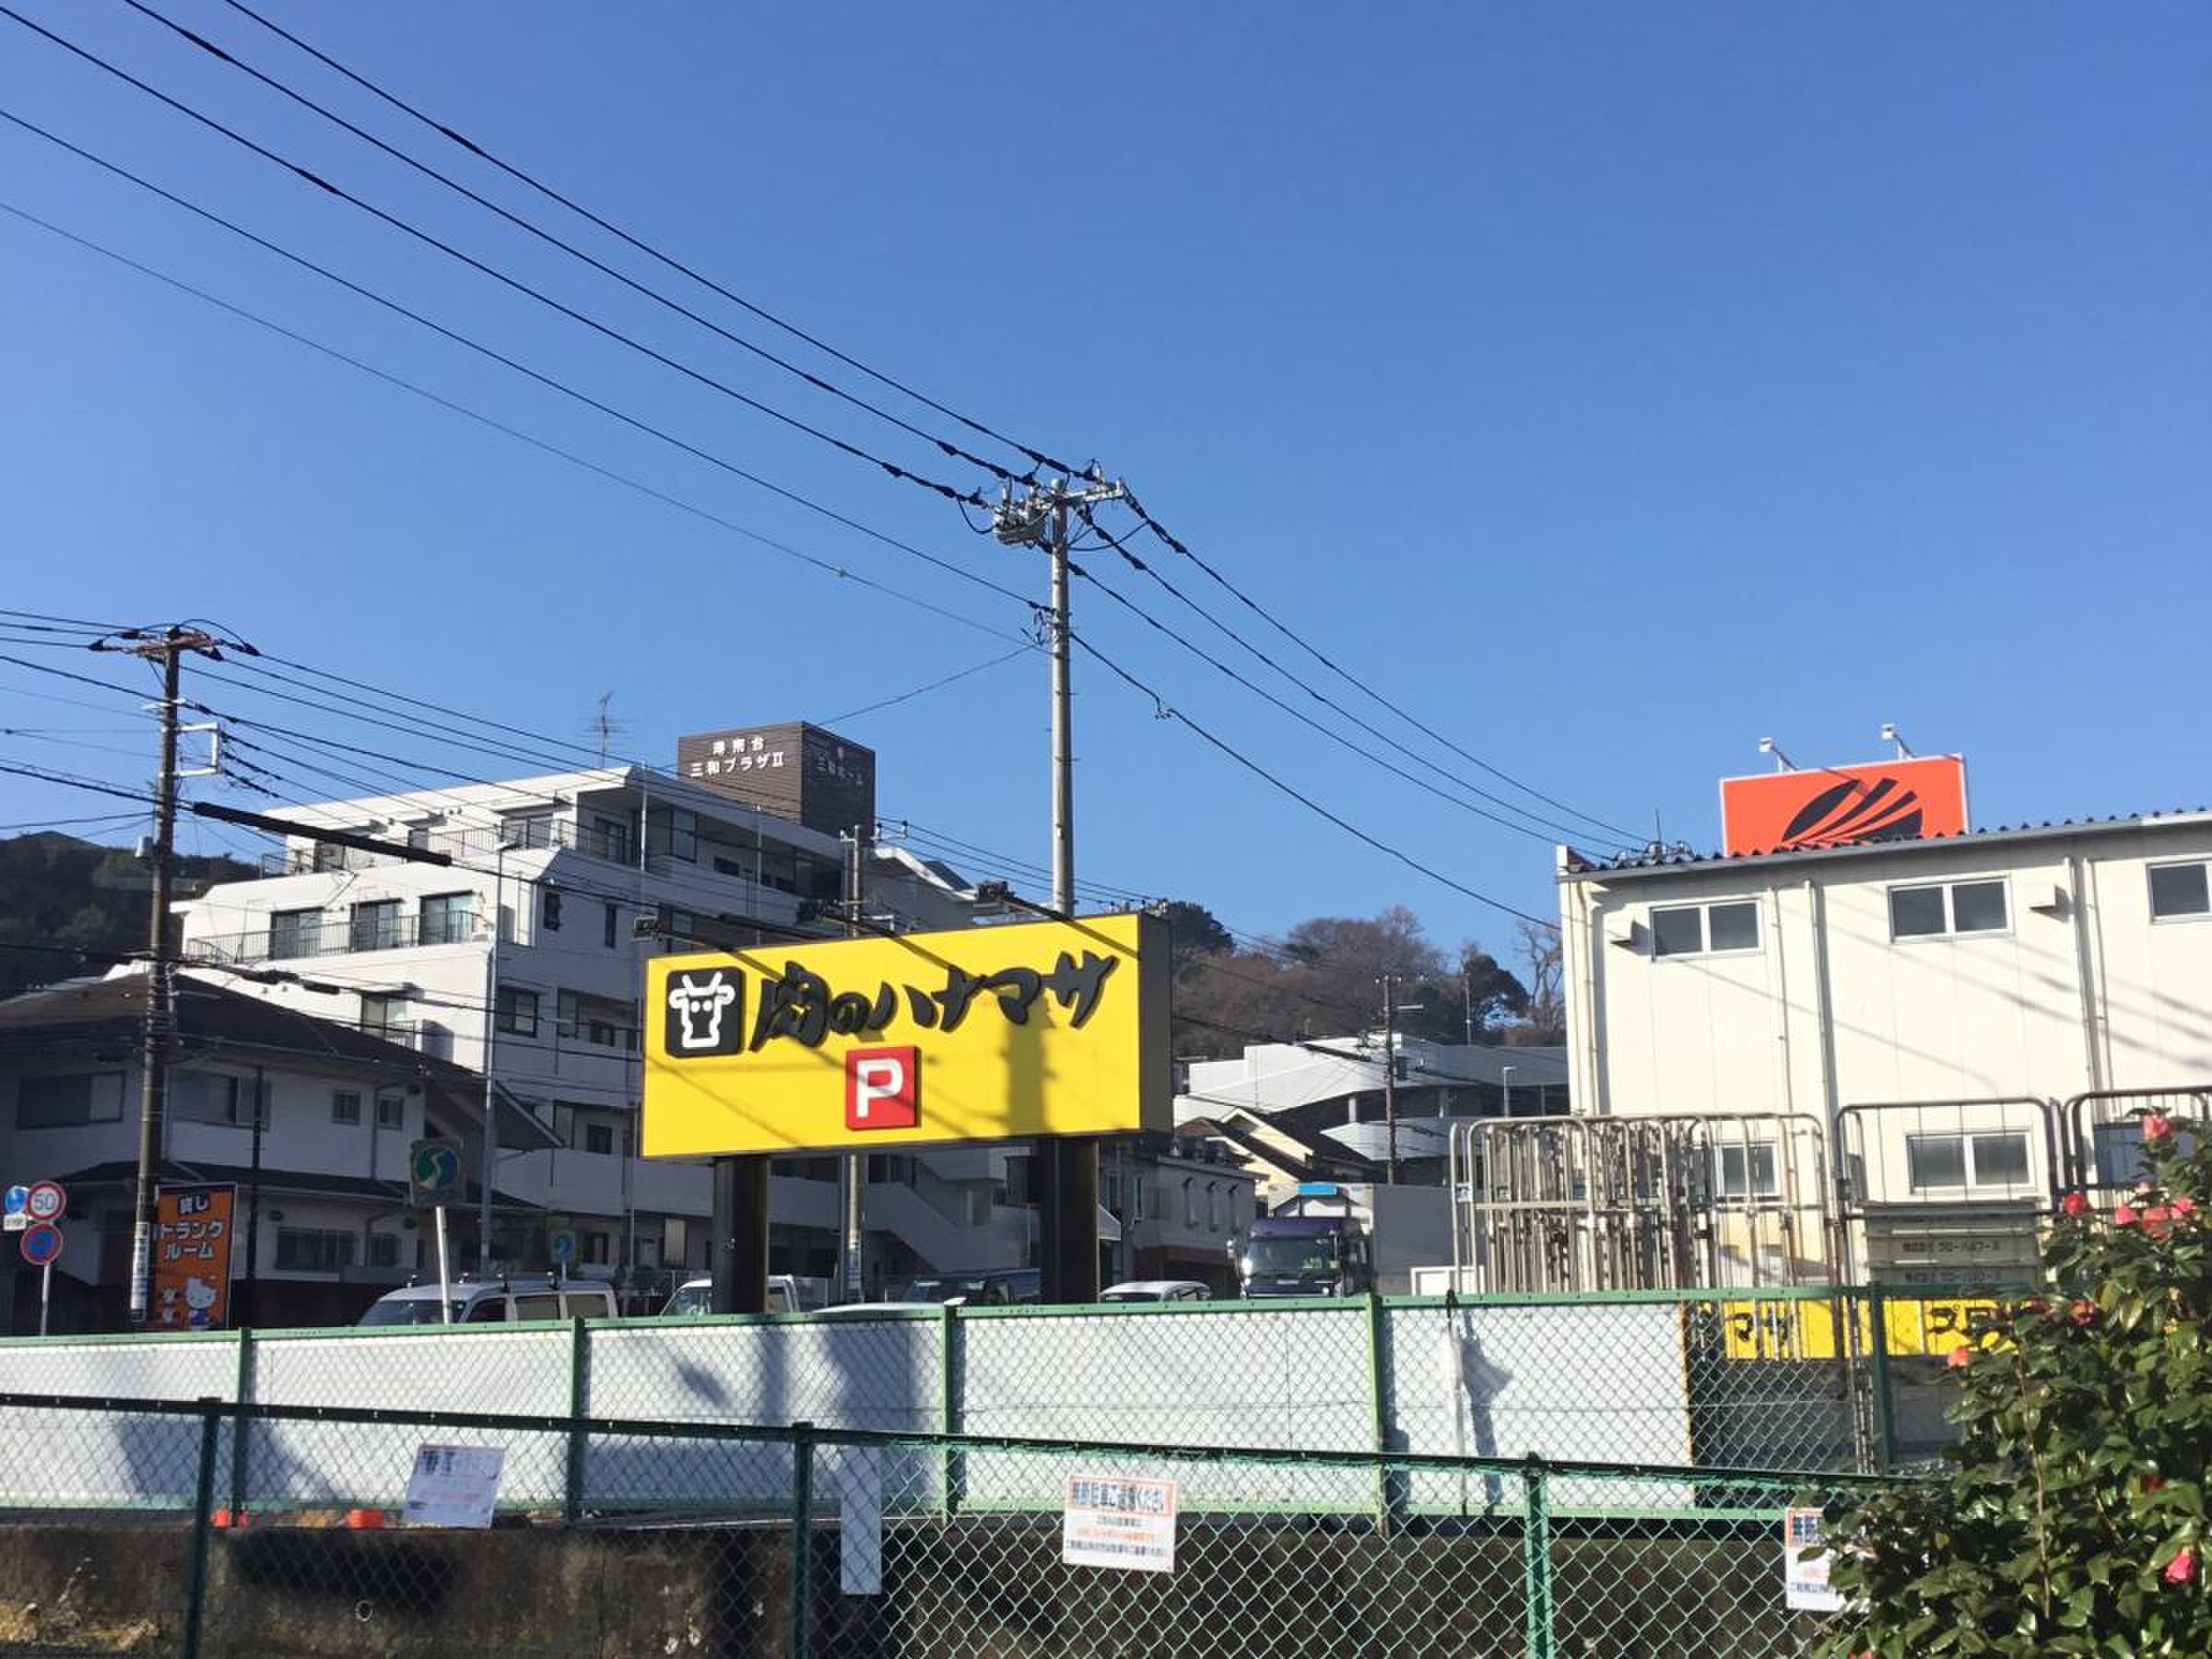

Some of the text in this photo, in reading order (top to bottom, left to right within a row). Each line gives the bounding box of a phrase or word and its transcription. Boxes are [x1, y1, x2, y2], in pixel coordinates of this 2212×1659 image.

[856, 1060, 903, 1117] P
[33, 1192, 59, 1211] 50
[161, 1221, 224, 1240] トランク
[164, 1242, 214, 1260] ルーム
